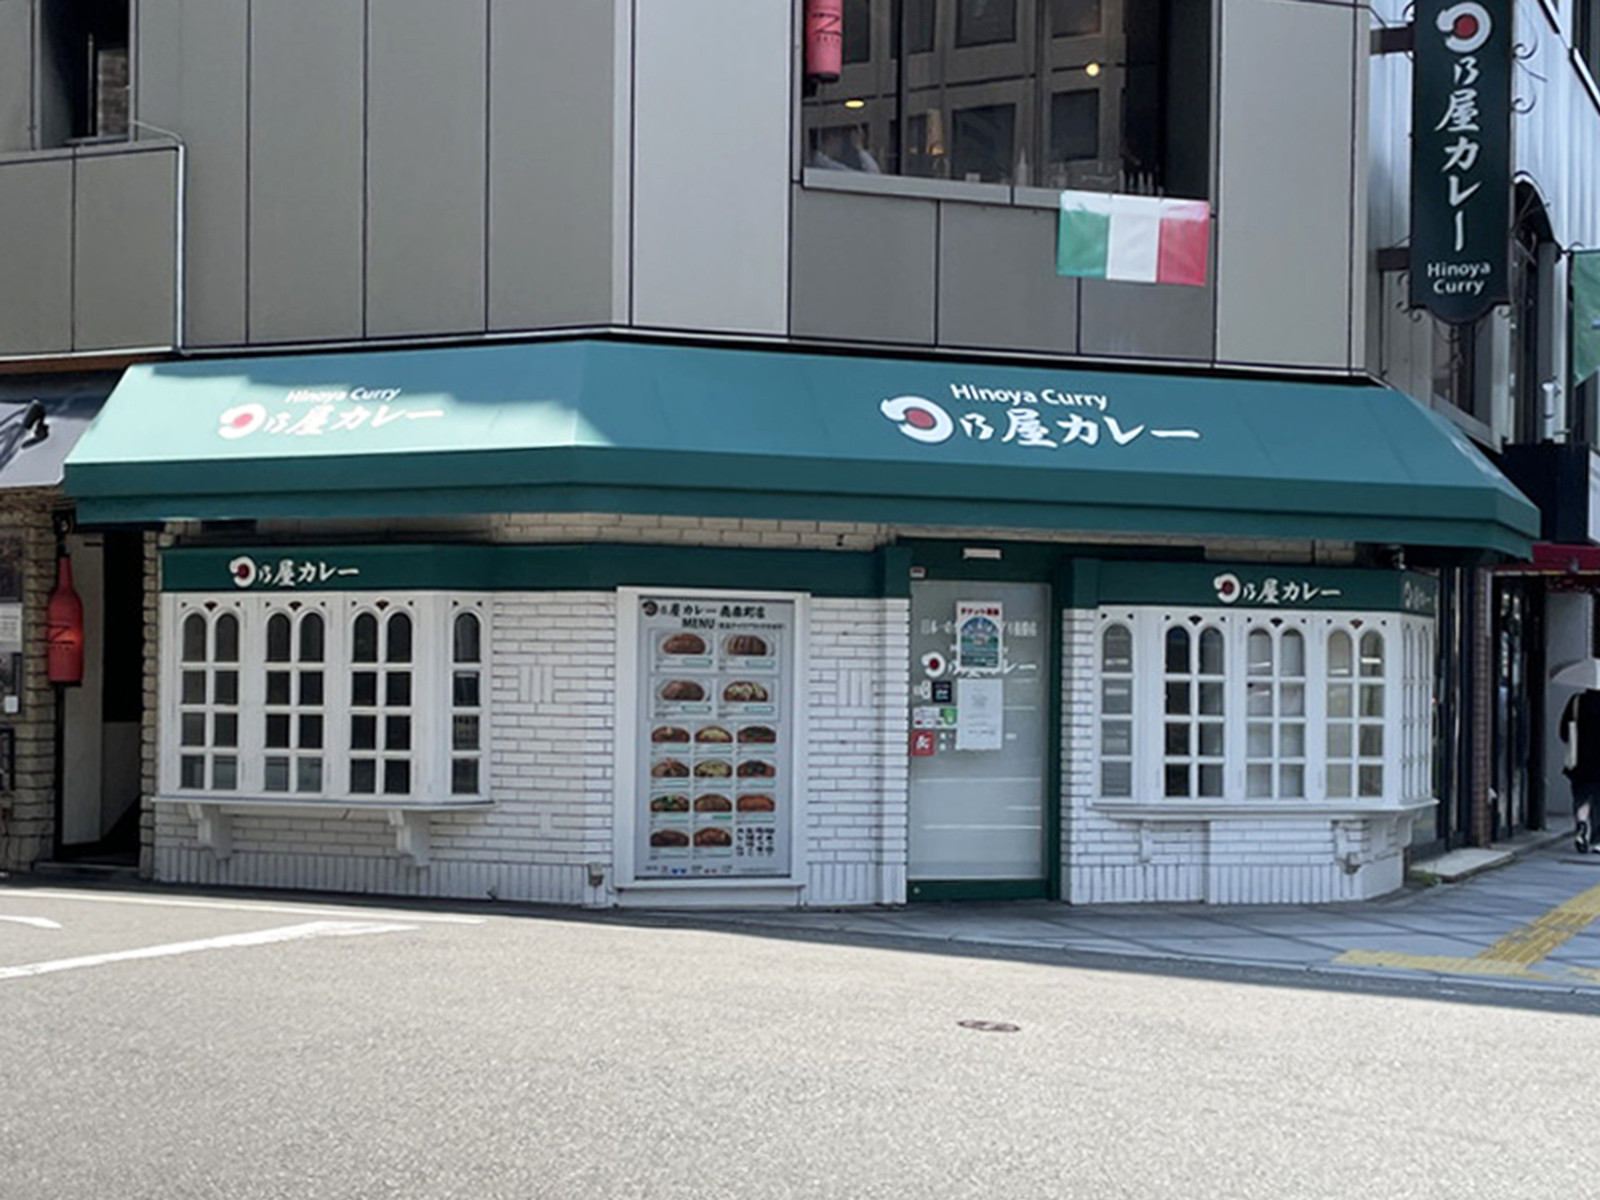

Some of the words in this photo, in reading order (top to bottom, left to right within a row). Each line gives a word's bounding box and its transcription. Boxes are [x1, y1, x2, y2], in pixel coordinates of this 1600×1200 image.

[1427, 261, 1491, 279] Hinoya
[1433, 278, 1485, 296] Curry
[285, 388, 347, 404] Hinoya
[350, 386, 401, 401] Curry
[950, 383, 1037, 405] Hinoya
[1041, 388, 1108, 411] Curry
[681, 617, 716, 630] MENU
